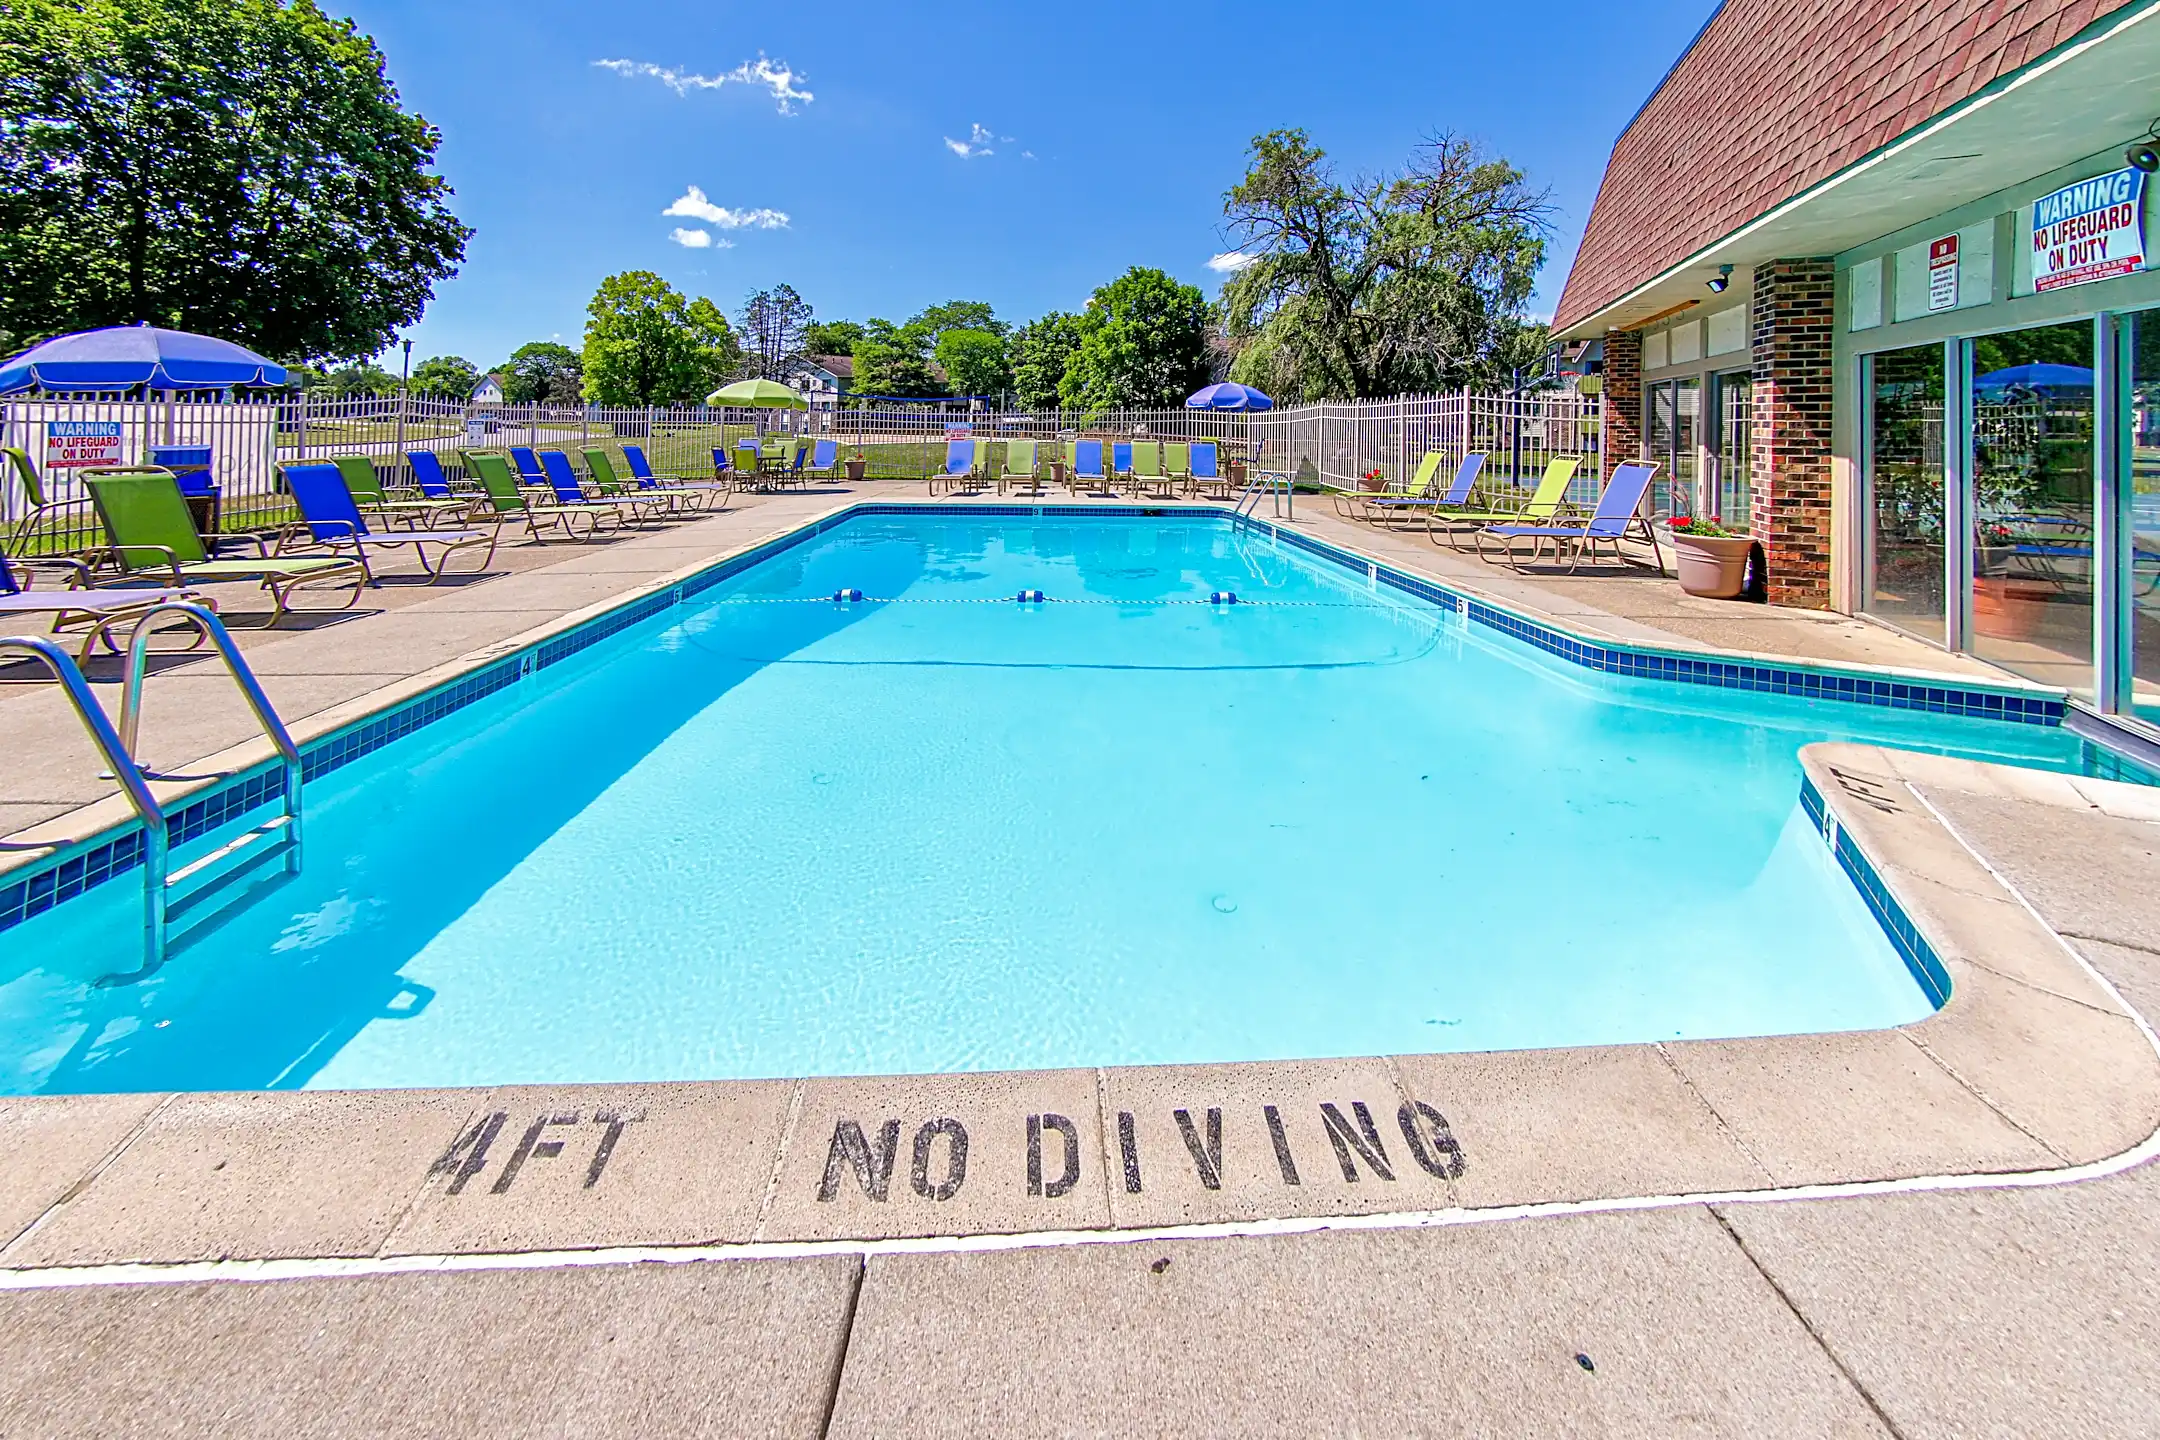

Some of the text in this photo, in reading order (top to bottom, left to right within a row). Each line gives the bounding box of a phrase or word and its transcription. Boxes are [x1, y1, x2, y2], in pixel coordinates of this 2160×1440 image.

[2039, 172, 2131, 227] WARNING
[2034, 203, 2132, 252] NO LIFEGUARD
[2048, 235, 2108, 272] ON DUTY
[54, 422, 117, 436] WARNING
[49, 437, 63, 448] NO
[67, 436, 119, 447] LIFEGUARD
[62, 448, 105, 459] ON DUTY
[1458, 599, 1464, 613] 5
[522, 656, 530, 675] 4
[1825, 813, 1831, 842] 4
[425, 1100, 1467, 1202] 4FT NO DIVING
